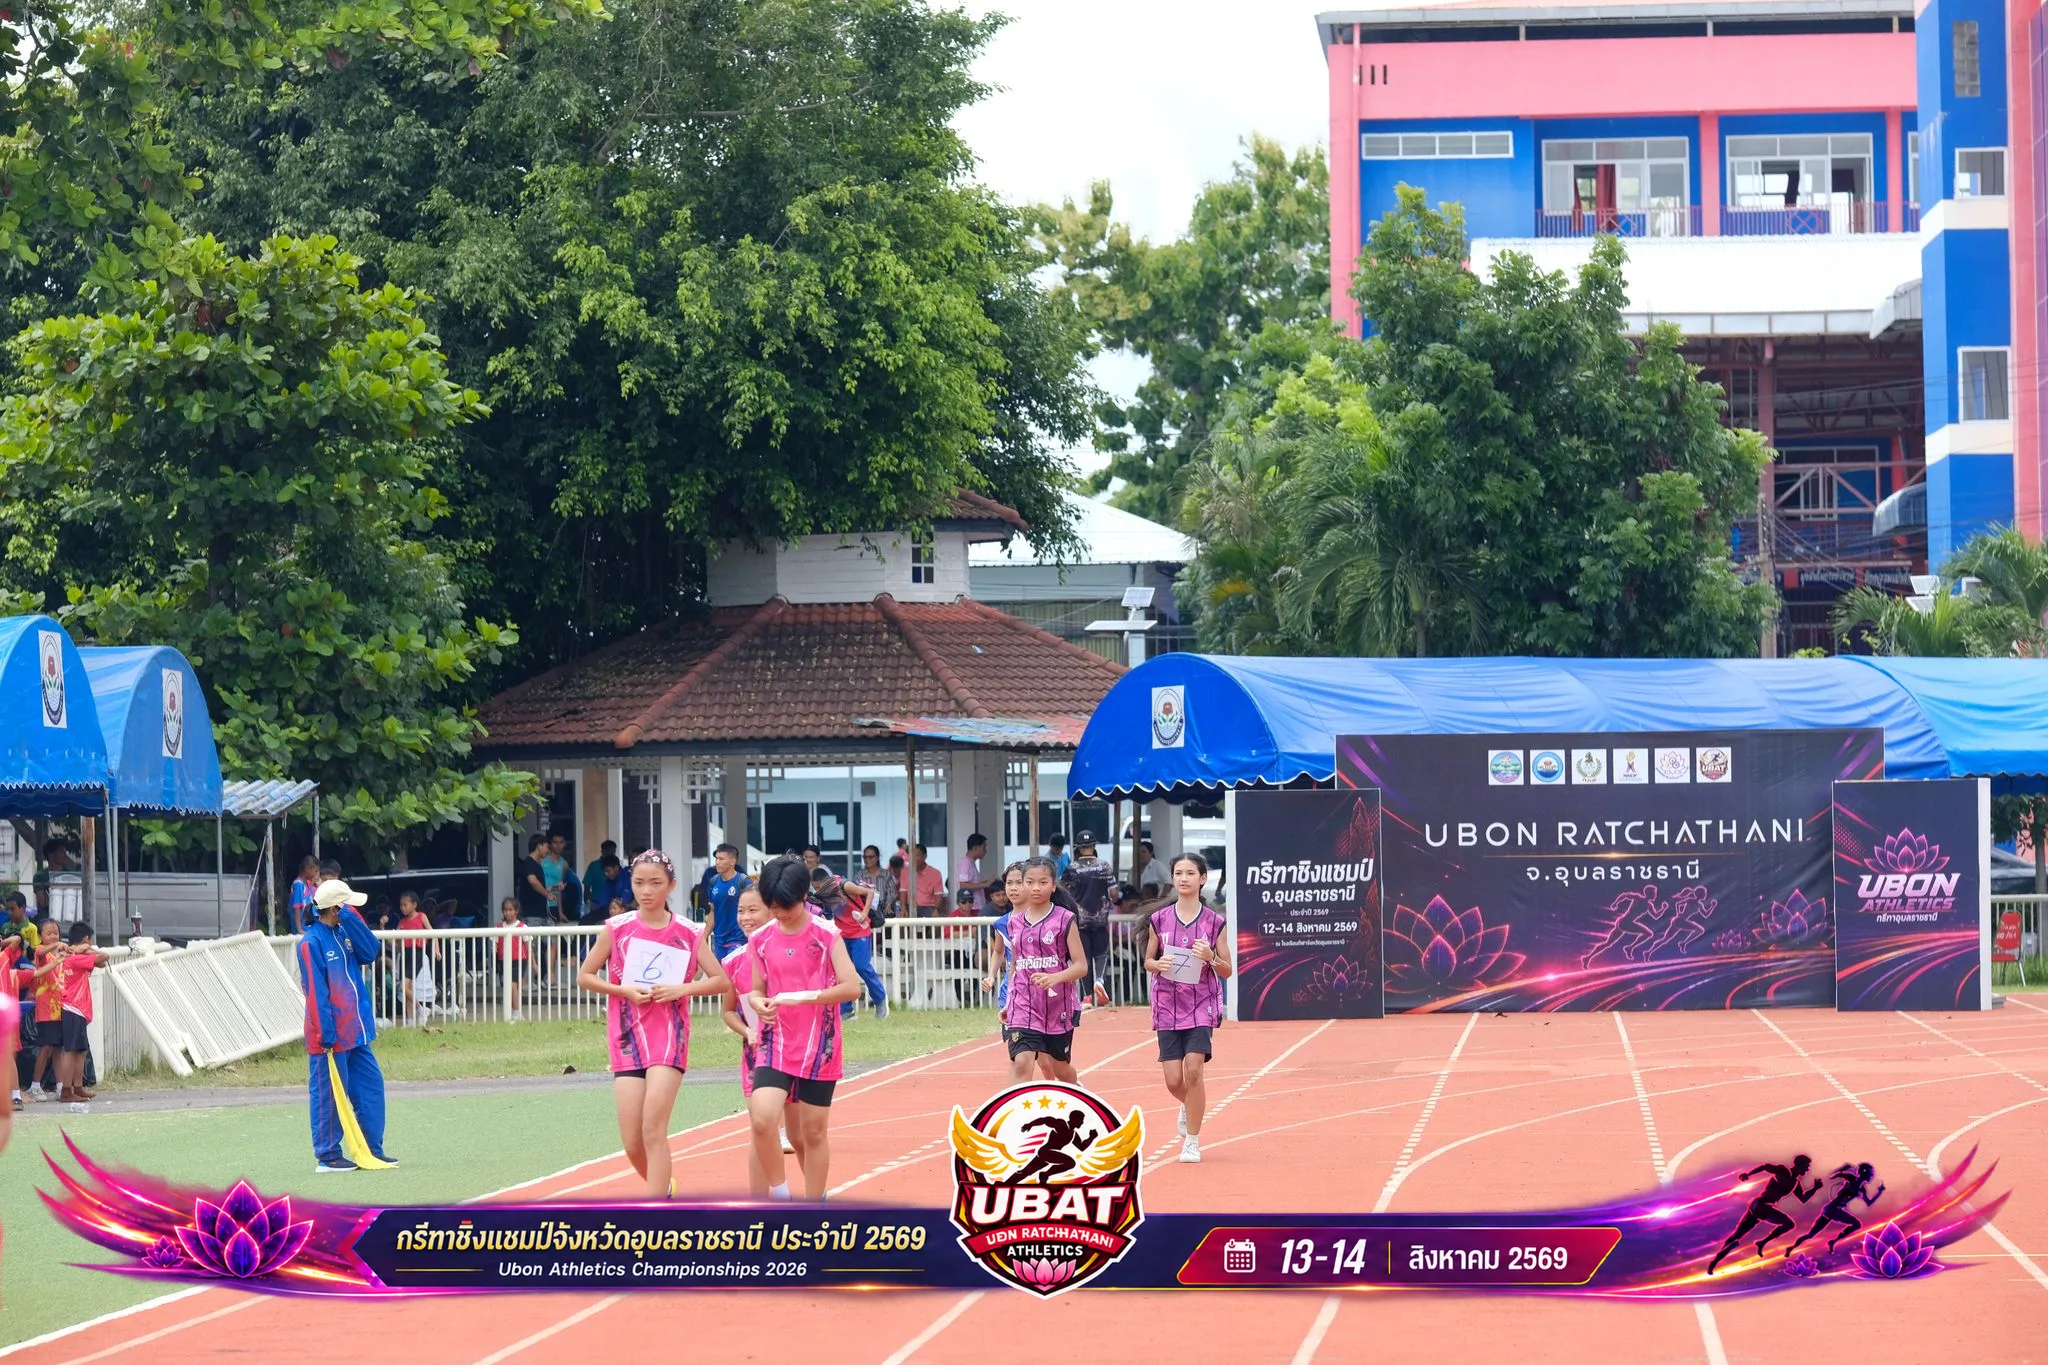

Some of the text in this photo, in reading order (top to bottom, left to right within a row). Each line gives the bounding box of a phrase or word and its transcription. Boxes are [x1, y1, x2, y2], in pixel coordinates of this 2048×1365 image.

[1425, 818, 1804, 848] UBON RATCHATHANI
[1526, 859, 1700, 887] จ.อุบลราชธานี
[1857, 872, 1962, 898] UBON
[1261, 884, 1356, 908] จ.อุบลราชธานี
[1858, 897, 1957, 913] ATHLETICS
[1262, 921, 1358, 934] 12-14 สิงหาคม 2569
[642, 951, 663, 981] 6
[1172, 952, 1191, 975] 7
